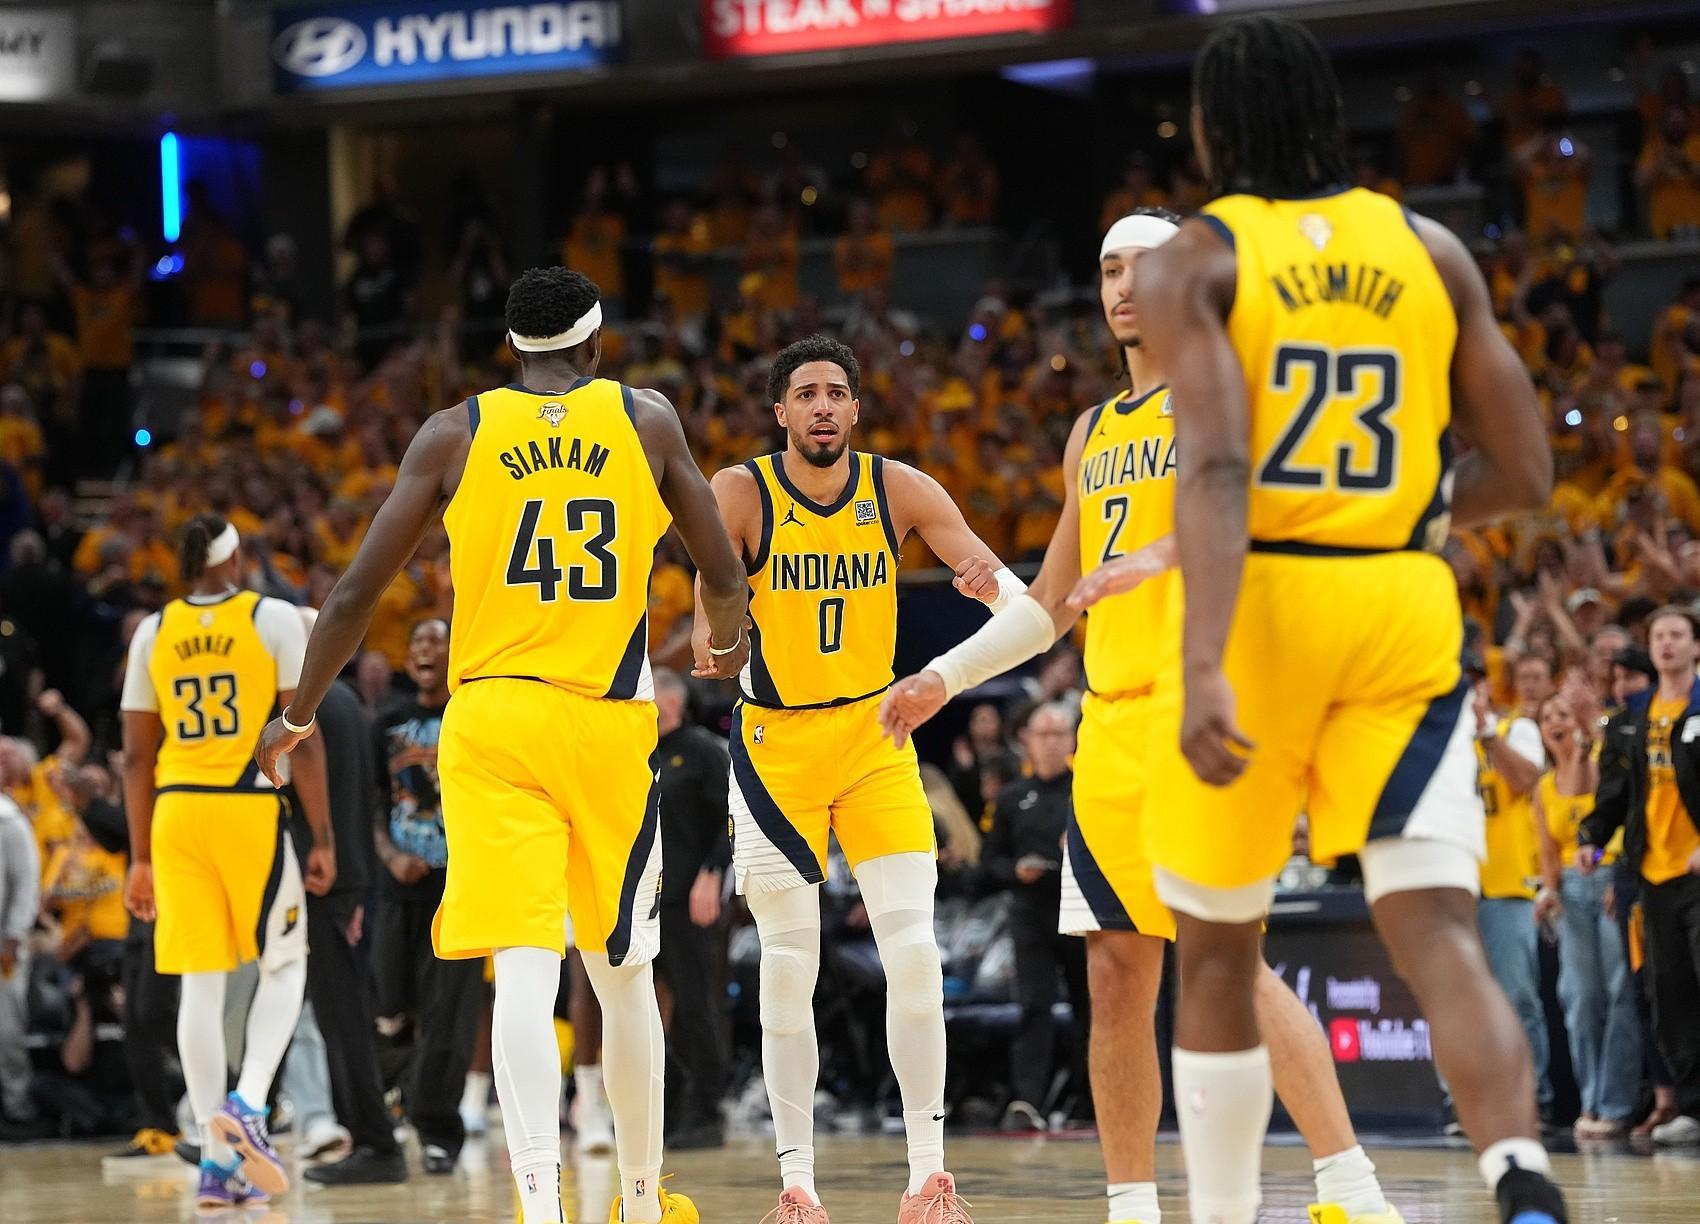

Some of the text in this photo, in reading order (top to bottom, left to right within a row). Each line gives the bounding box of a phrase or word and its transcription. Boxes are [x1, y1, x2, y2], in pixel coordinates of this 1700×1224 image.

[373, 2, 622, 67] HYUNDAI
[1270, 262, 1405, 319] NESMITH
[1260, 346, 1397, 490] 23
[500, 437, 610, 481] SIAKAM
[1080, 435, 1176, 496] NDIANA
[506, 498, 618, 602] 43
[1102, 497, 1128, 563] 2
[771, 551, 888, 591] INDIANA
[174, 634, 234, 661] TURNER
[818, 597, 845, 654] 0
[175, 674, 238, 739] 33
